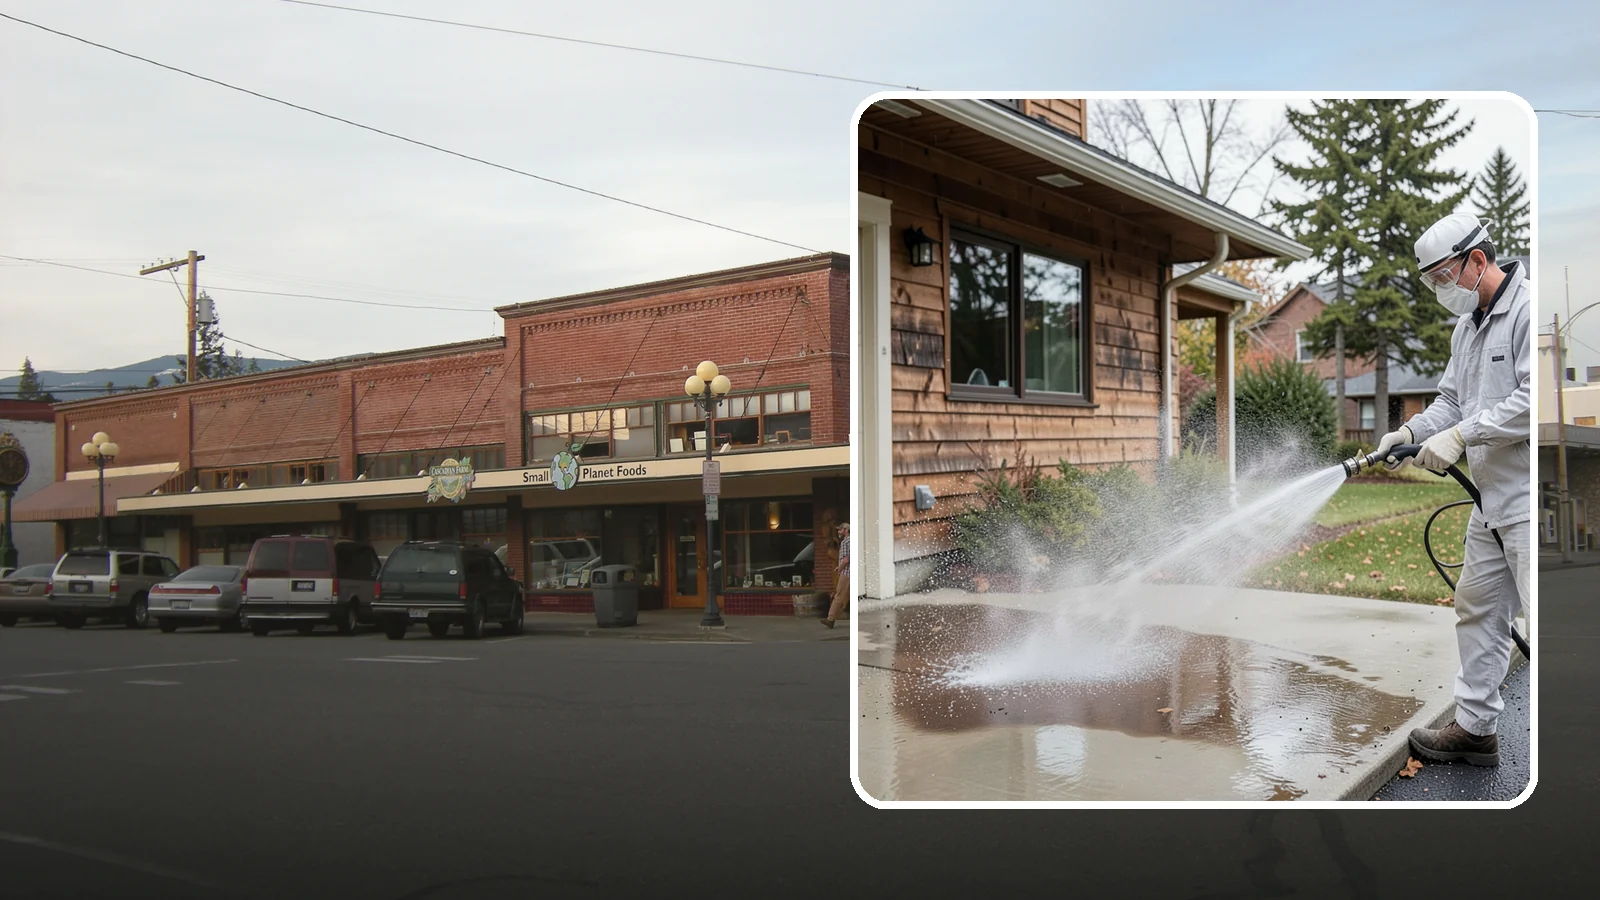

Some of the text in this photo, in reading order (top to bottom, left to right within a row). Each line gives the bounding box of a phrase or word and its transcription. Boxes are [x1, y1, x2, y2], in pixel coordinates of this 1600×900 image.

[523, 464, 647, 482] Small Planet Foods
